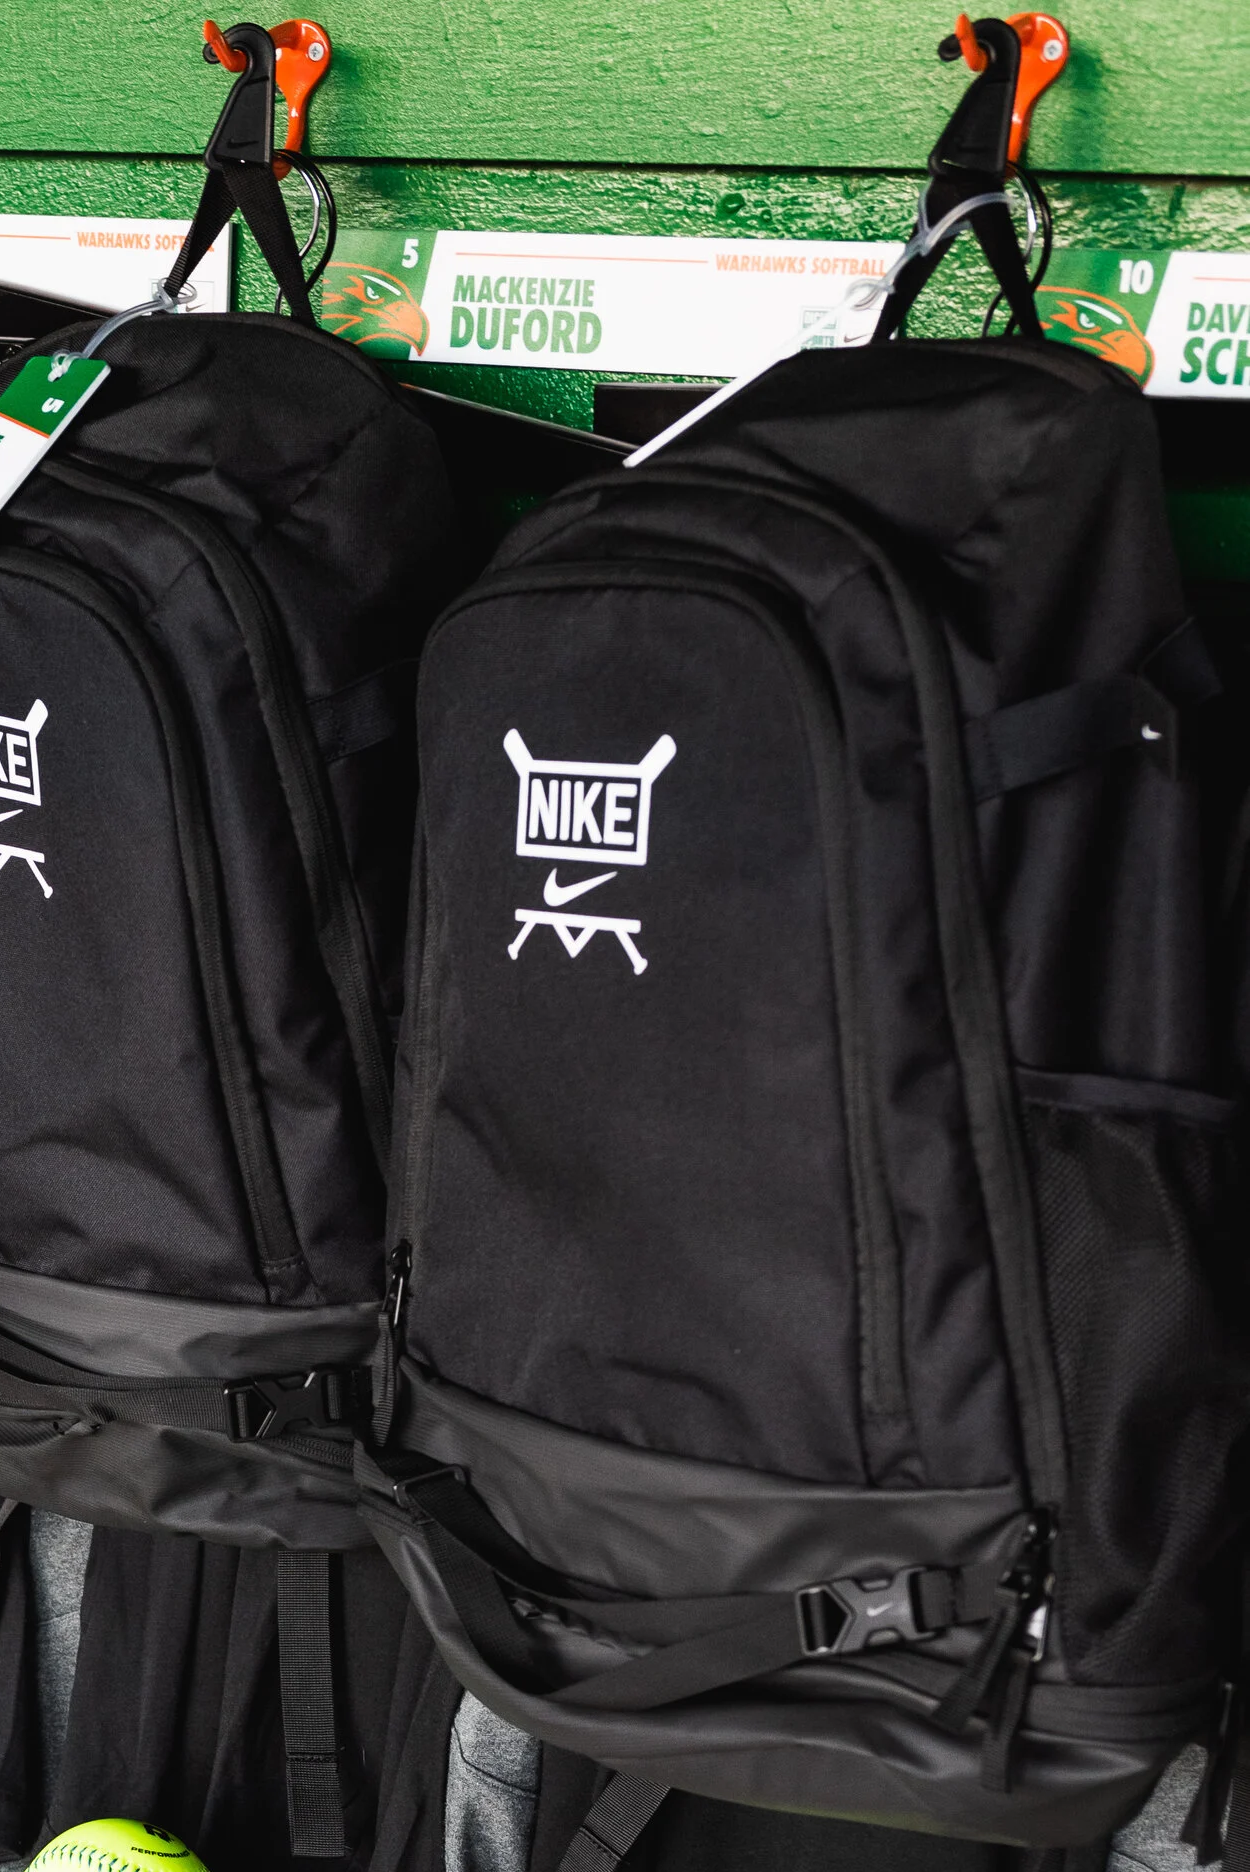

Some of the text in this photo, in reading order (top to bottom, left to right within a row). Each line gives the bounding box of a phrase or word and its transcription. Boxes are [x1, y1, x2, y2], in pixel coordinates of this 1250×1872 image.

[77, 231, 151, 250] WARHAWKS
[401, 238, 419, 269] 5
[715, 253, 888, 277] WARHAWKS SOFTBALL
[1118, 259, 1154, 295] 10
[452, 274, 595, 308] MACKENZIE
[449, 306, 602, 354] DUFORD
[1187, 302, 1250, 334] DAV
[41, 397, 65, 414] 5
[528, 778, 637, 847] NIKE
